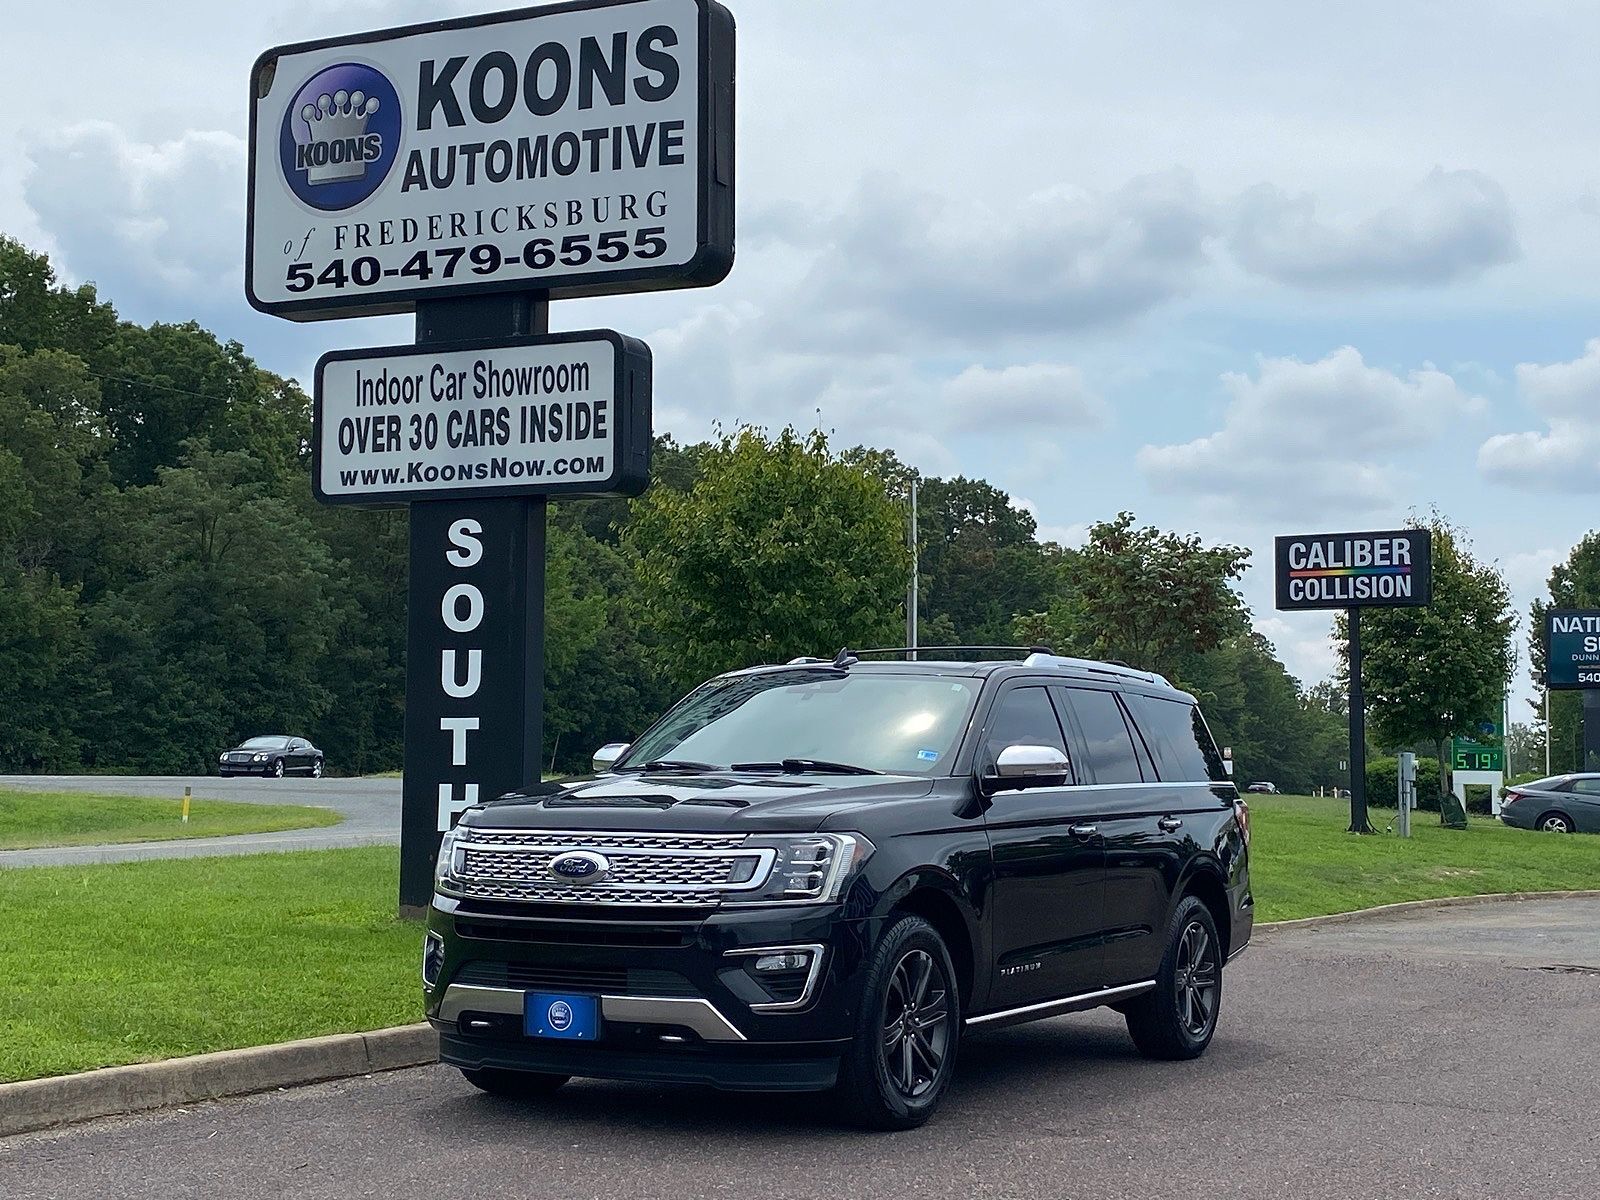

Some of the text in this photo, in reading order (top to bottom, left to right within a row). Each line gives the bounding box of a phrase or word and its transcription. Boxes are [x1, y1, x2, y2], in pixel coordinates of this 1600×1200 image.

[416, 25, 680, 131] KOONS
[297, 134, 382, 169] KOONS
[401, 120, 685, 193] AUTOMOTIVE
[283, 190, 669, 261] of FREDERICKSBURG
[285, 227, 668, 293] 540-479-6555
[356, 360, 590, 407] Indoor Car Showroom
[338, 400, 607, 455] OVER 30 CARS INSIDE
[1288, 538, 1412, 570] CALIBER
[1289, 575, 1412, 601] COLLISION
[1583, 636, 1600, 653] S
[437, 518, 485, 832] SOUTH
[560, 859, 588, 873] Ford
